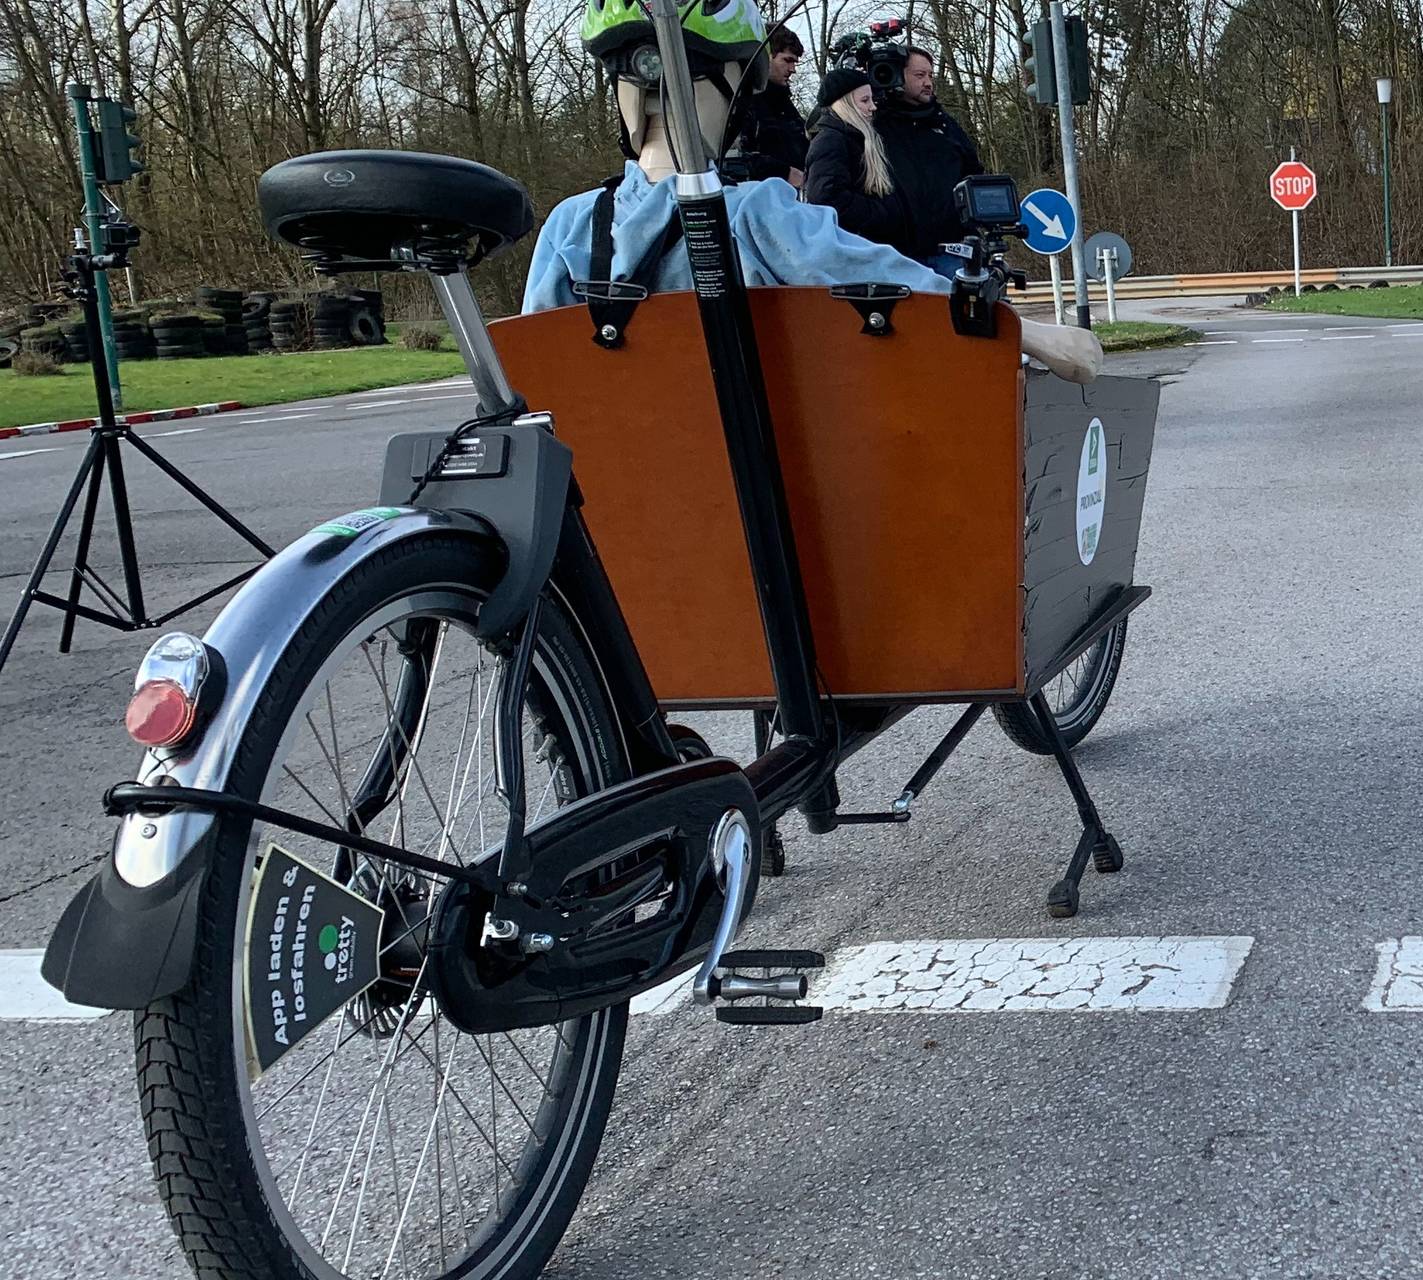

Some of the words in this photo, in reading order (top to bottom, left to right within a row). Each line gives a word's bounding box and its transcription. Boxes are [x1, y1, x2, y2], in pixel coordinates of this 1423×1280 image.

[1275, 176, 1311, 196] STOP
[283, 866, 299, 887] &
[267, 896, 290, 981] laden
[291, 885, 316, 1022] losfahren
[335, 916, 355, 984] tretty
[274, 990, 289, 1045] App
